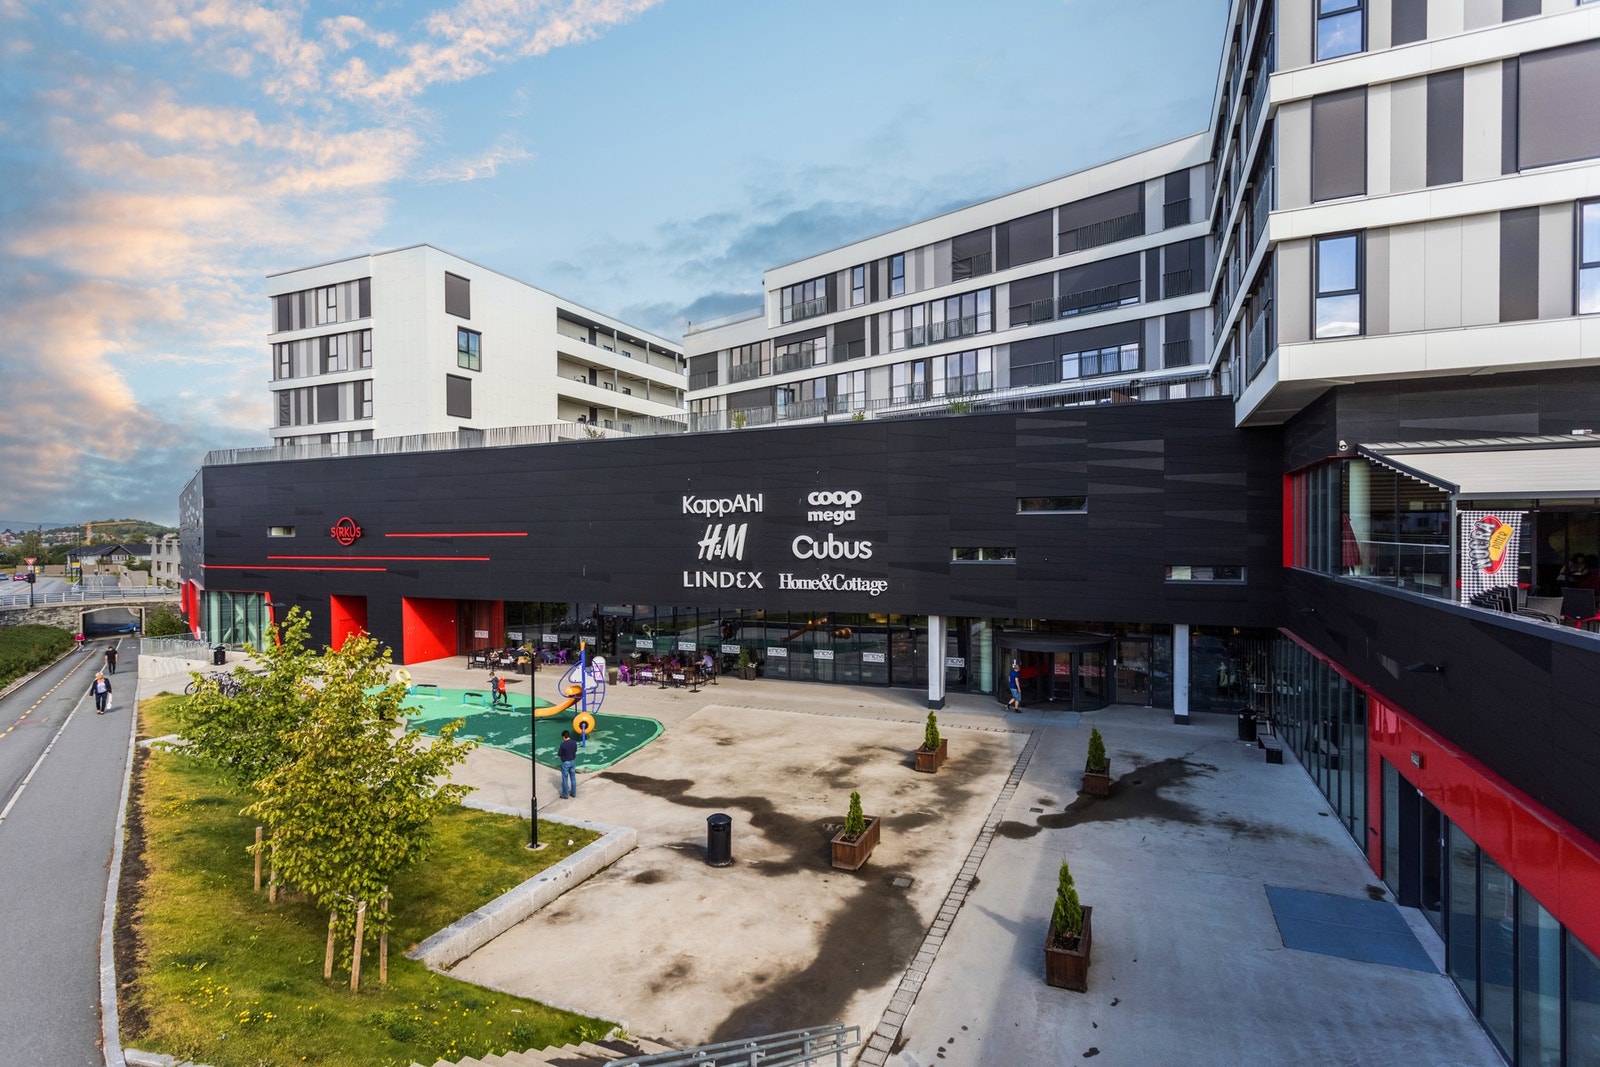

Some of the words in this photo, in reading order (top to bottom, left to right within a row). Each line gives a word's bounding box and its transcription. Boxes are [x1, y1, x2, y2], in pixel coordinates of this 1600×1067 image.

[682, 493, 763, 517] KappAhl
[807, 490, 863, 508] coop
[807, 509, 856, 525] mega
[697, 523, 748, 561] H&M
[792, 533, 873, 559] Cubus
[683, 571, 764, 589] LINDEX
[778, 573, 888, 596] Home&Cottage
